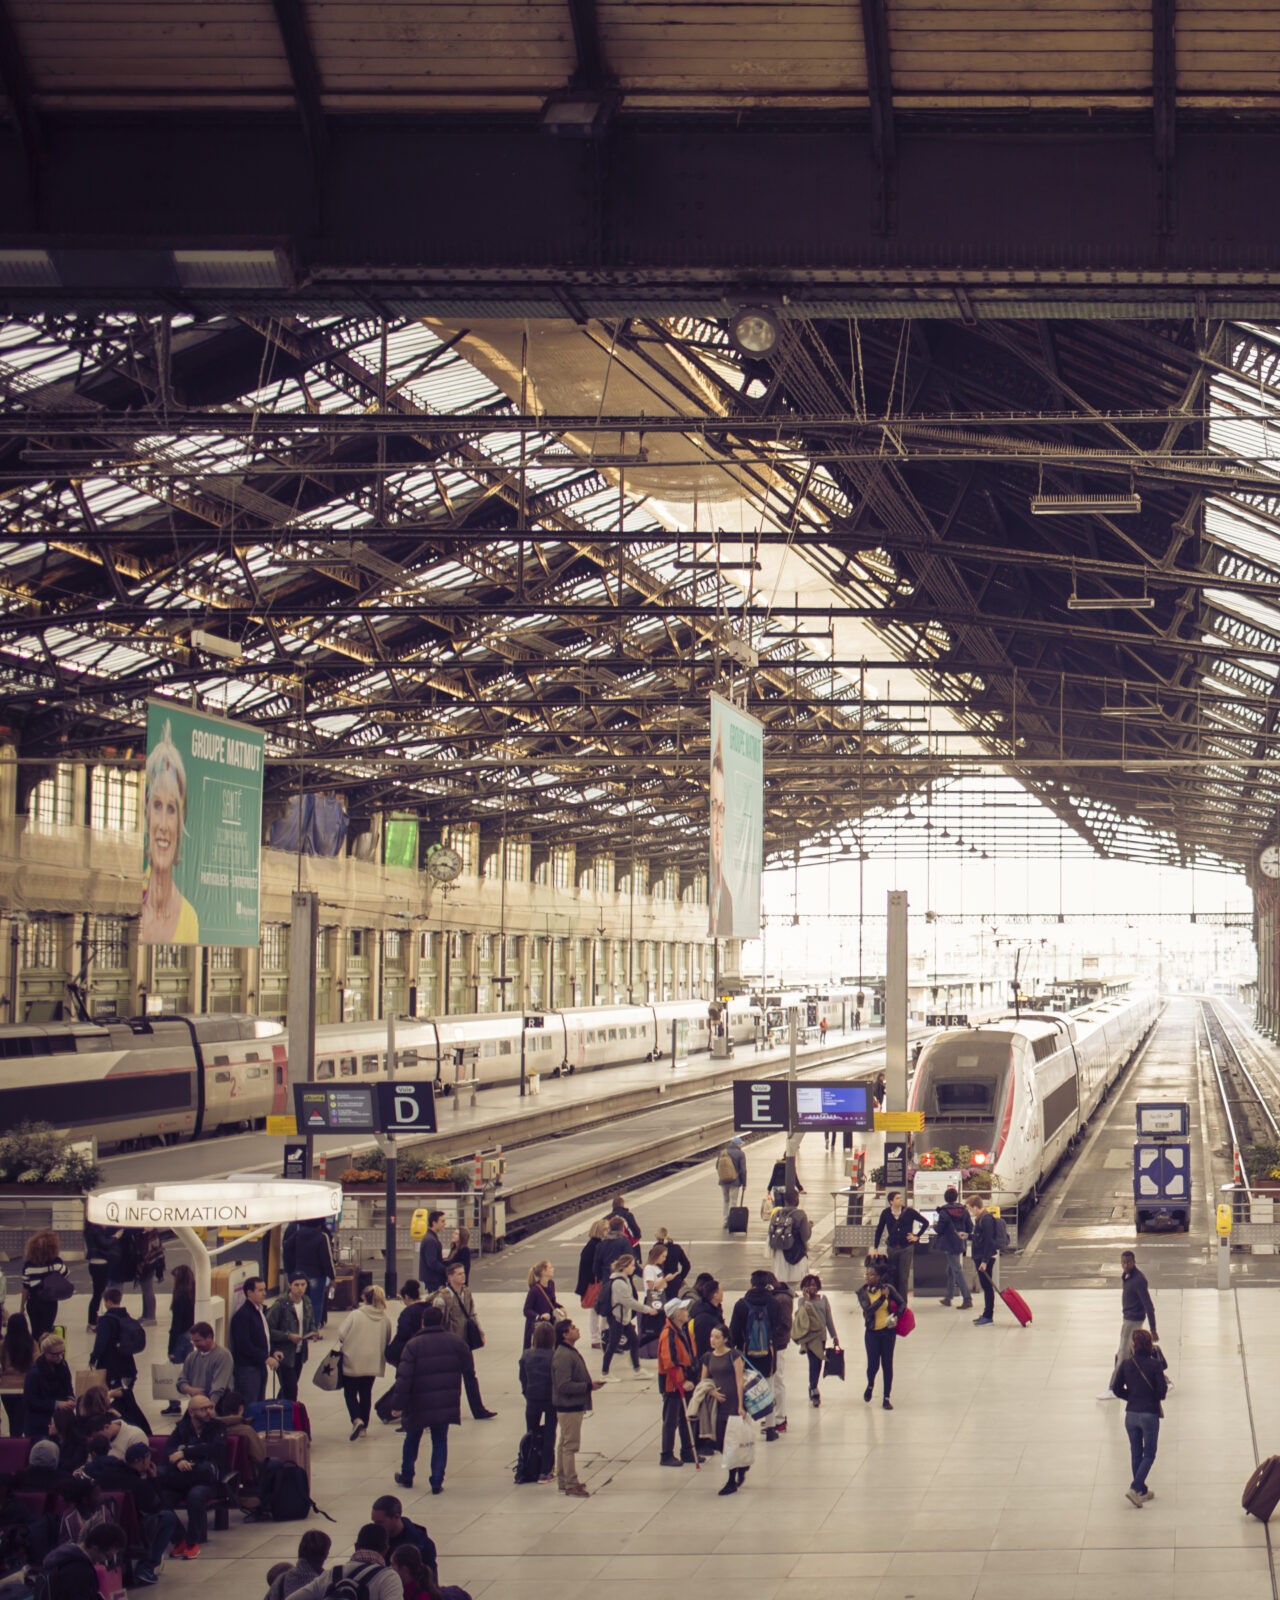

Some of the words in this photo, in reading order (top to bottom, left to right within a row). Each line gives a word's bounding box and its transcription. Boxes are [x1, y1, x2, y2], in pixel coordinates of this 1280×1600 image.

[191, 729, 226, 764] GROUPE
[226, 738, 261, 772] MATMUT
[222, 789, 242, 821] SANTÉ
[528, 1019, 535, 1028] R
[230, 1077, 237, 1097] 2
[394, 1096, 420, 1123] D
[751, 1095, 772, 1121] E
[125, 1205, 248, 1222] INFORMATION
